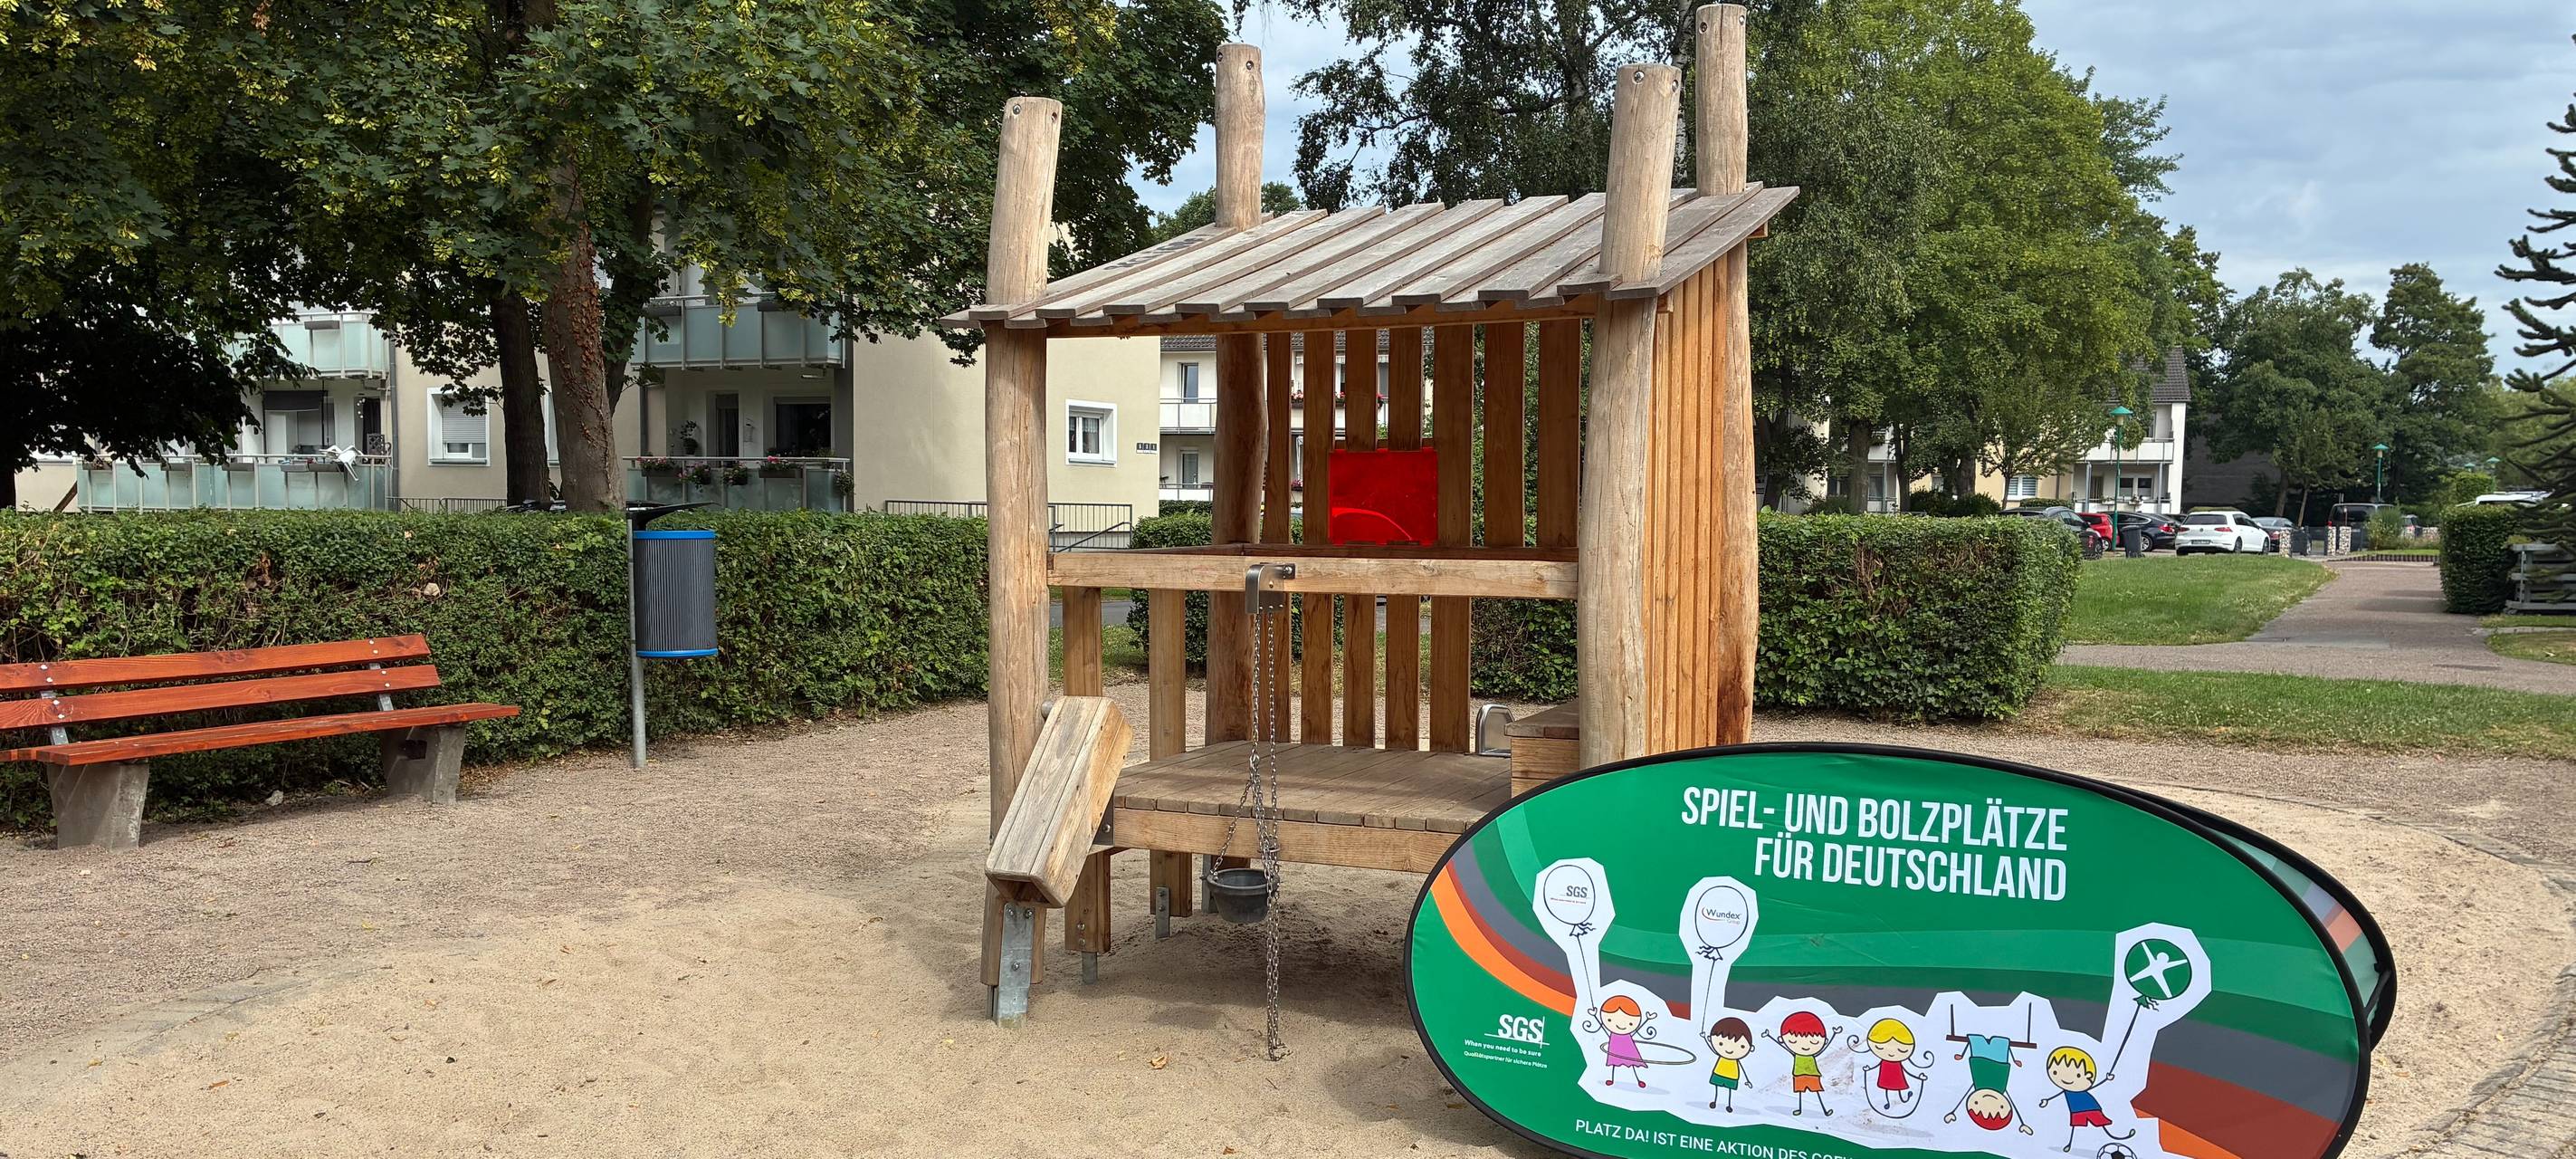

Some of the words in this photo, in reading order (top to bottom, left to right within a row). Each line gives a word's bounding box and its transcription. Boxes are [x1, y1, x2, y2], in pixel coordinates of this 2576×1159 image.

[1681, 786, 1775, 830] SPIEL-
[1784, 792, 1848, 836] UND
[1857, 797, 2069, 851] BOLZPLÄTZE
[1754, 831, 1814, 881] FÜR
[1822, 842, 2066, 901] DEUTSCHLAND
[1566, 885, 1589, 898] SGS
[1706, 908, 1740, 920] Wundex
[1498, 1013, 1543, 1042] SGS
[1464, 1039, 1483, 1048] When
[1575, 1119, 1622, 1138] PLATZ
[1625, 1126, 1649, 1143] DA!
[1653, 1131, 1676, 1146] IST
[1679, 1135, 1713, 1152] EINE
[1717, 1140, 1774, 1159] AKTION
[1779, 1147, 1808, 1159] DES
